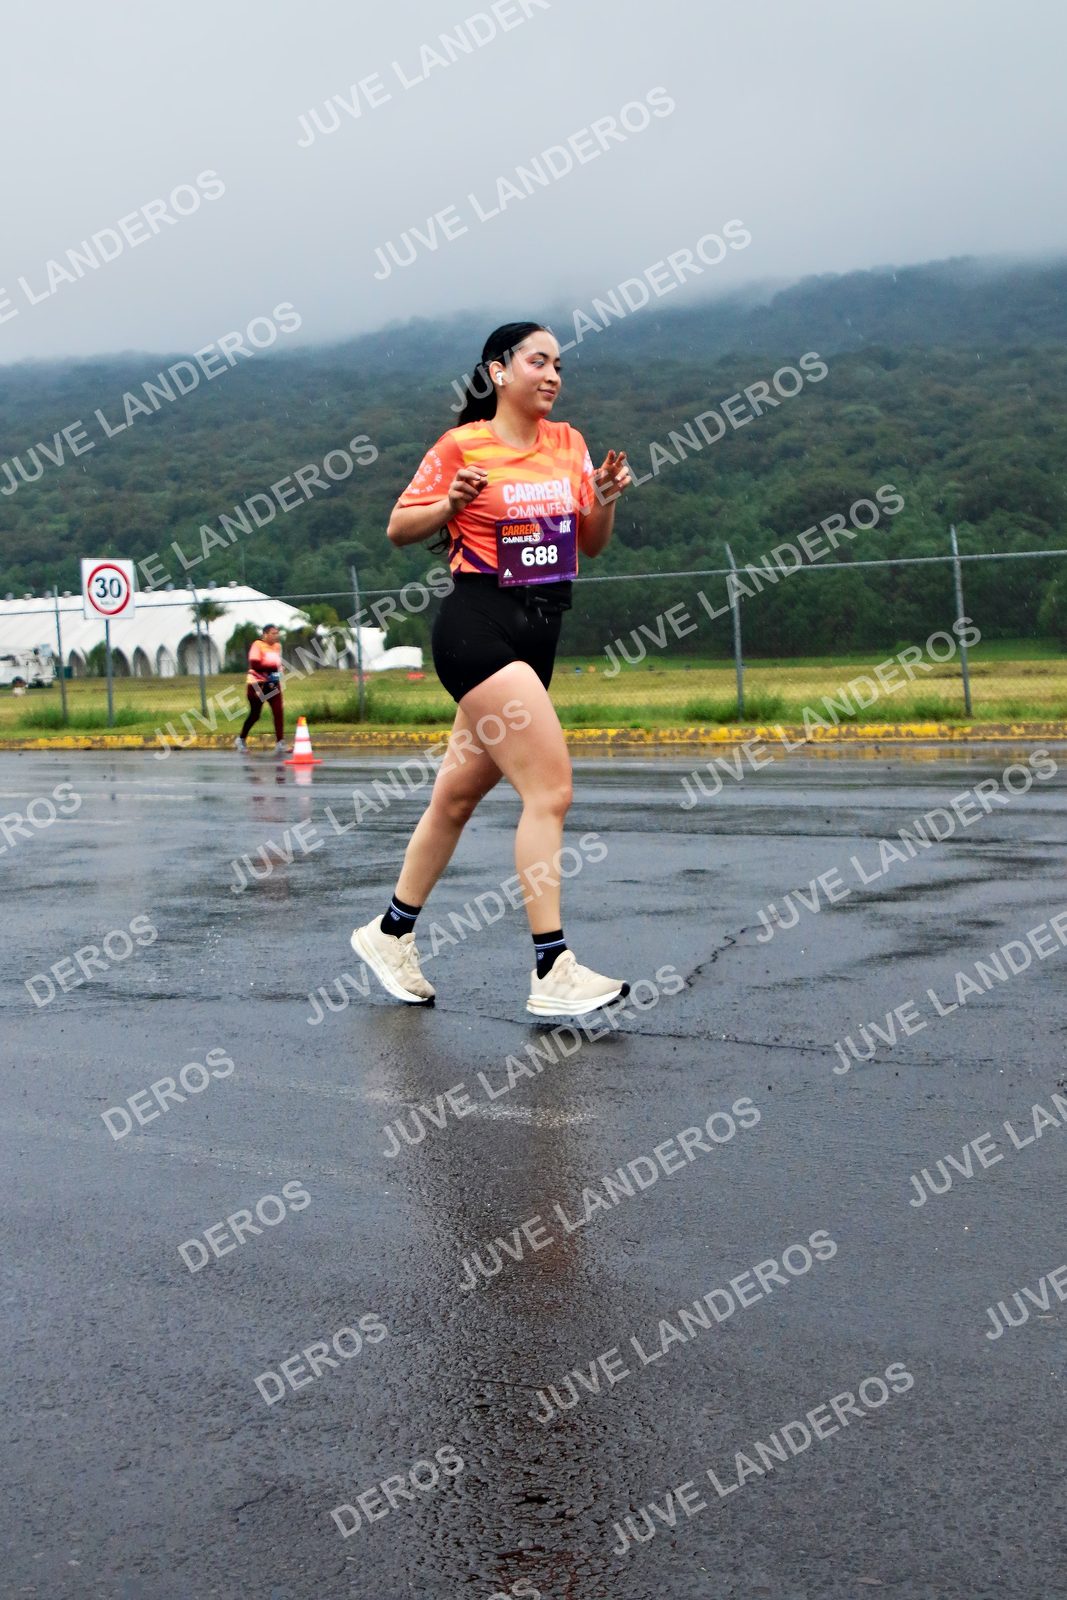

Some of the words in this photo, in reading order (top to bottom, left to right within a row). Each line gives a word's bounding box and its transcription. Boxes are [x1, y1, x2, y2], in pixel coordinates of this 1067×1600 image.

[502, 477, 571, 504] CARRERA
[507, 501, 561, 519] OMNILIFE
[502, 523, 541, 537] CARRERA
[521, 545, 558, 566] 688
[95, 577, 122, 598] 30
